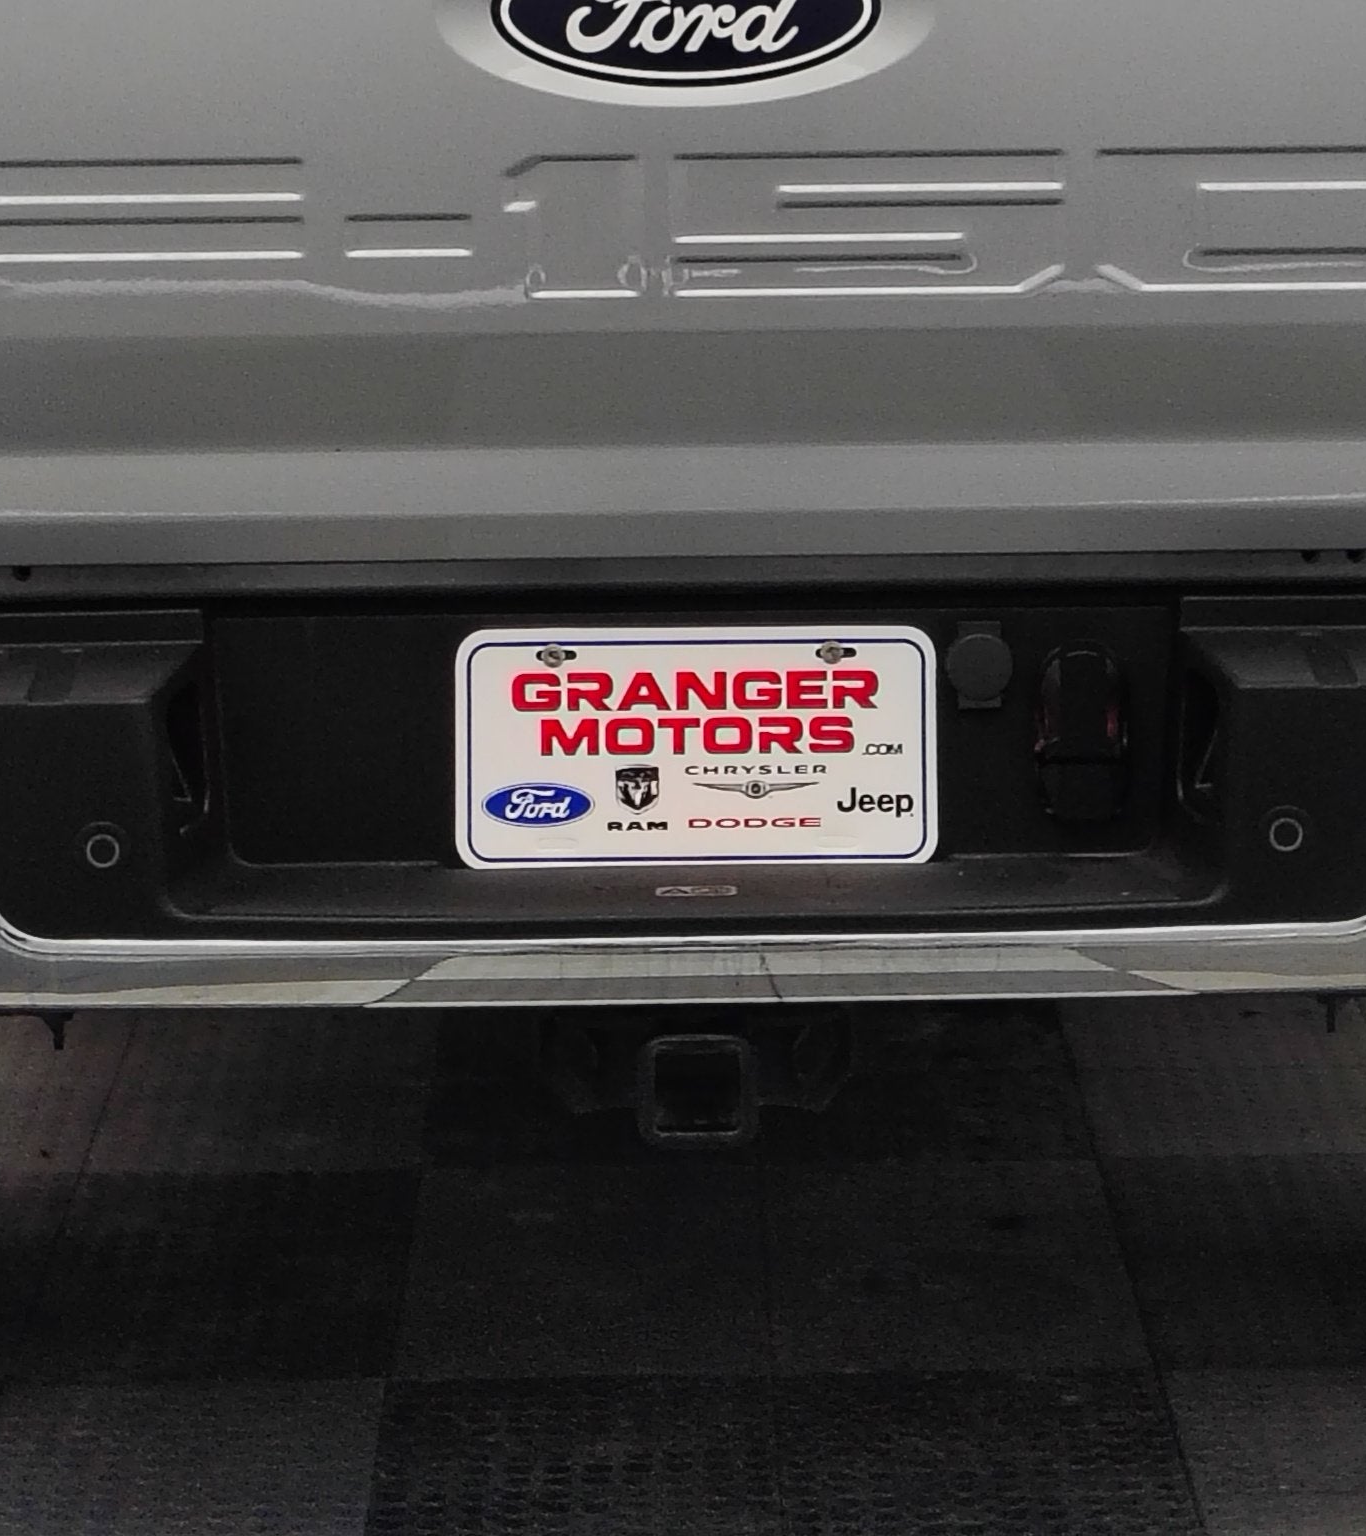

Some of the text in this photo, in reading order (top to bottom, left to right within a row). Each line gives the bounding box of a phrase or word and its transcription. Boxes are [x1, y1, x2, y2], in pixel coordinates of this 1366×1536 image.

[510, 669, 879, 713] GRANGER
[540, 715, 855, 757] MOTORS
[685, 764, 828, 776] CHRYSLER
[503, 788, 572, 821] Ford
[836, 787, 914, 818] Jeep
[607, 821, 668, 832] RAM
[688, 817, 822, 829] DODGE
